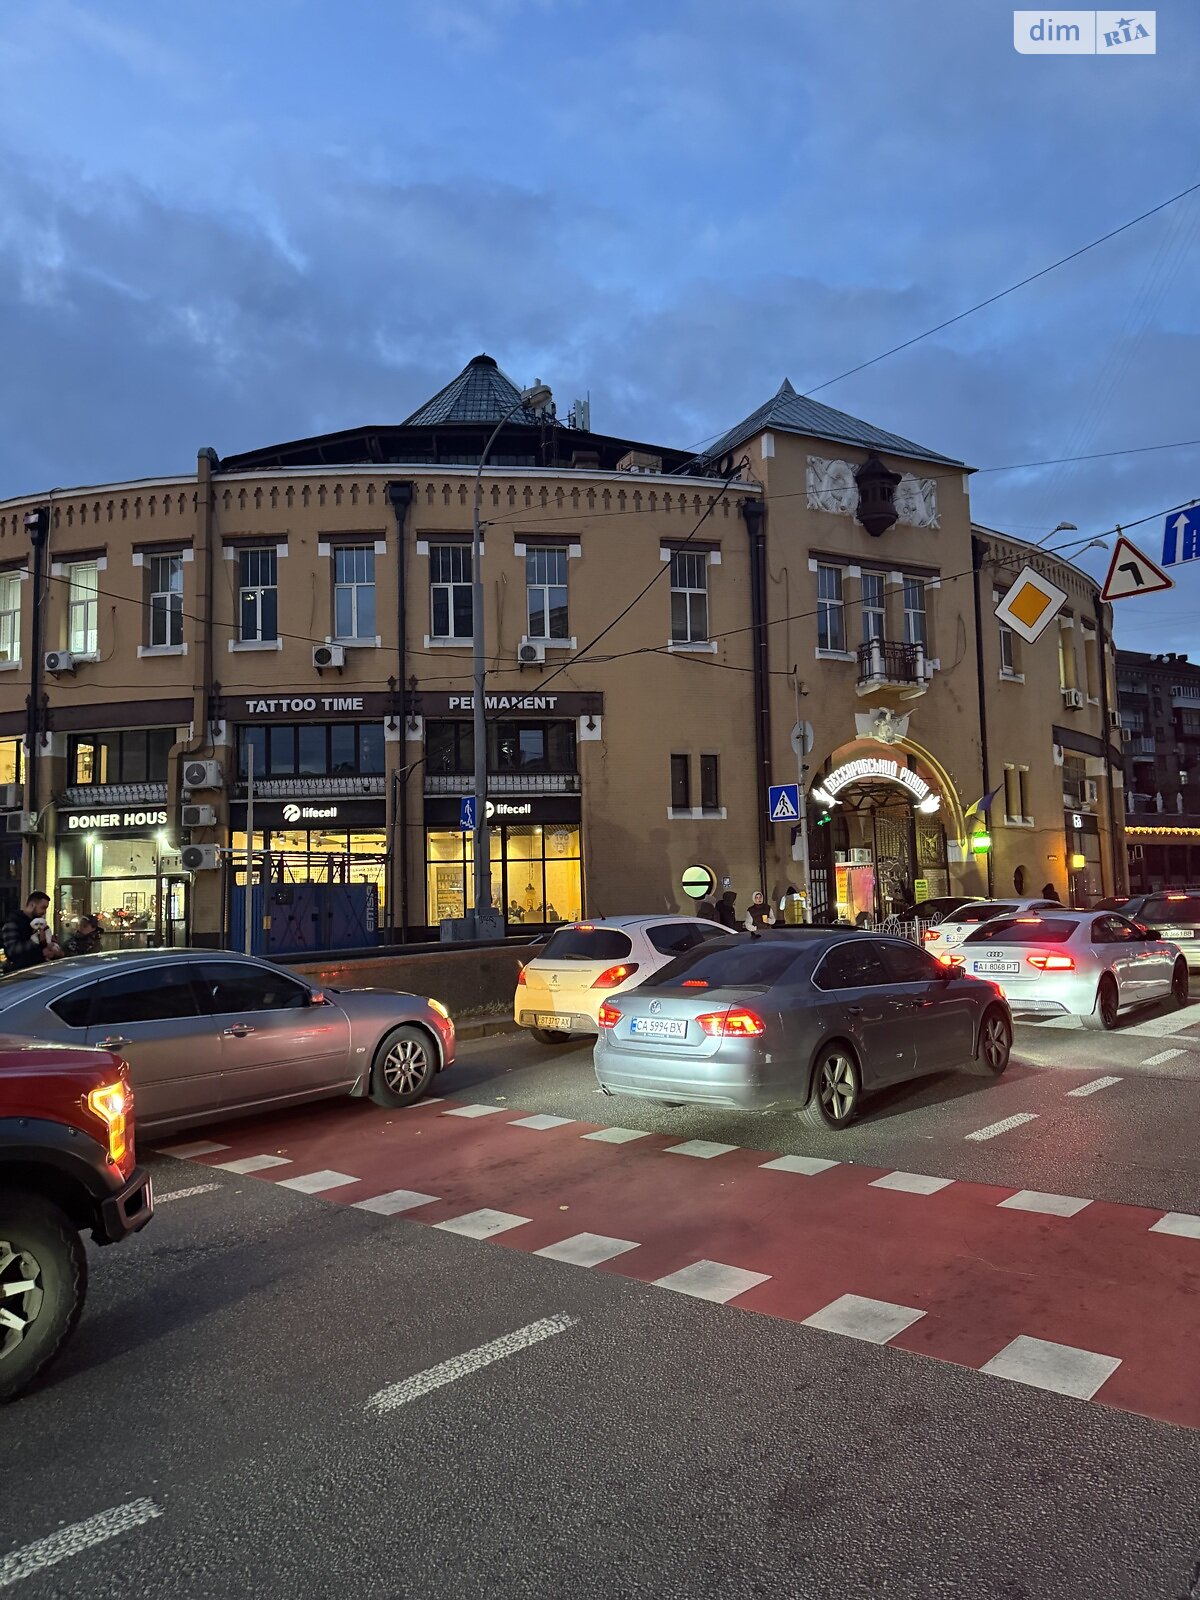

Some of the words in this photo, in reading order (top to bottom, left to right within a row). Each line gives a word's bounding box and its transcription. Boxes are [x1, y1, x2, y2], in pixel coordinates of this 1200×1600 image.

[245, 698, 316, 713] TATTOO
[321, 698, 364, 711] TIME
[900, 767, 930, 797] РИНОК
[302, 807, 338, 818] lifecell
[496, 803, 532, 814] lifecell
[68, 813, 121, 829] DONER
[123, 811, 168, 826] HOUS
[1006, 963, 1018, 971] PT
[637, 1020, 648, 1031] CA
[649, 1021, 669, 1033] 5994
[669, 1022, 683, 1034] BX
